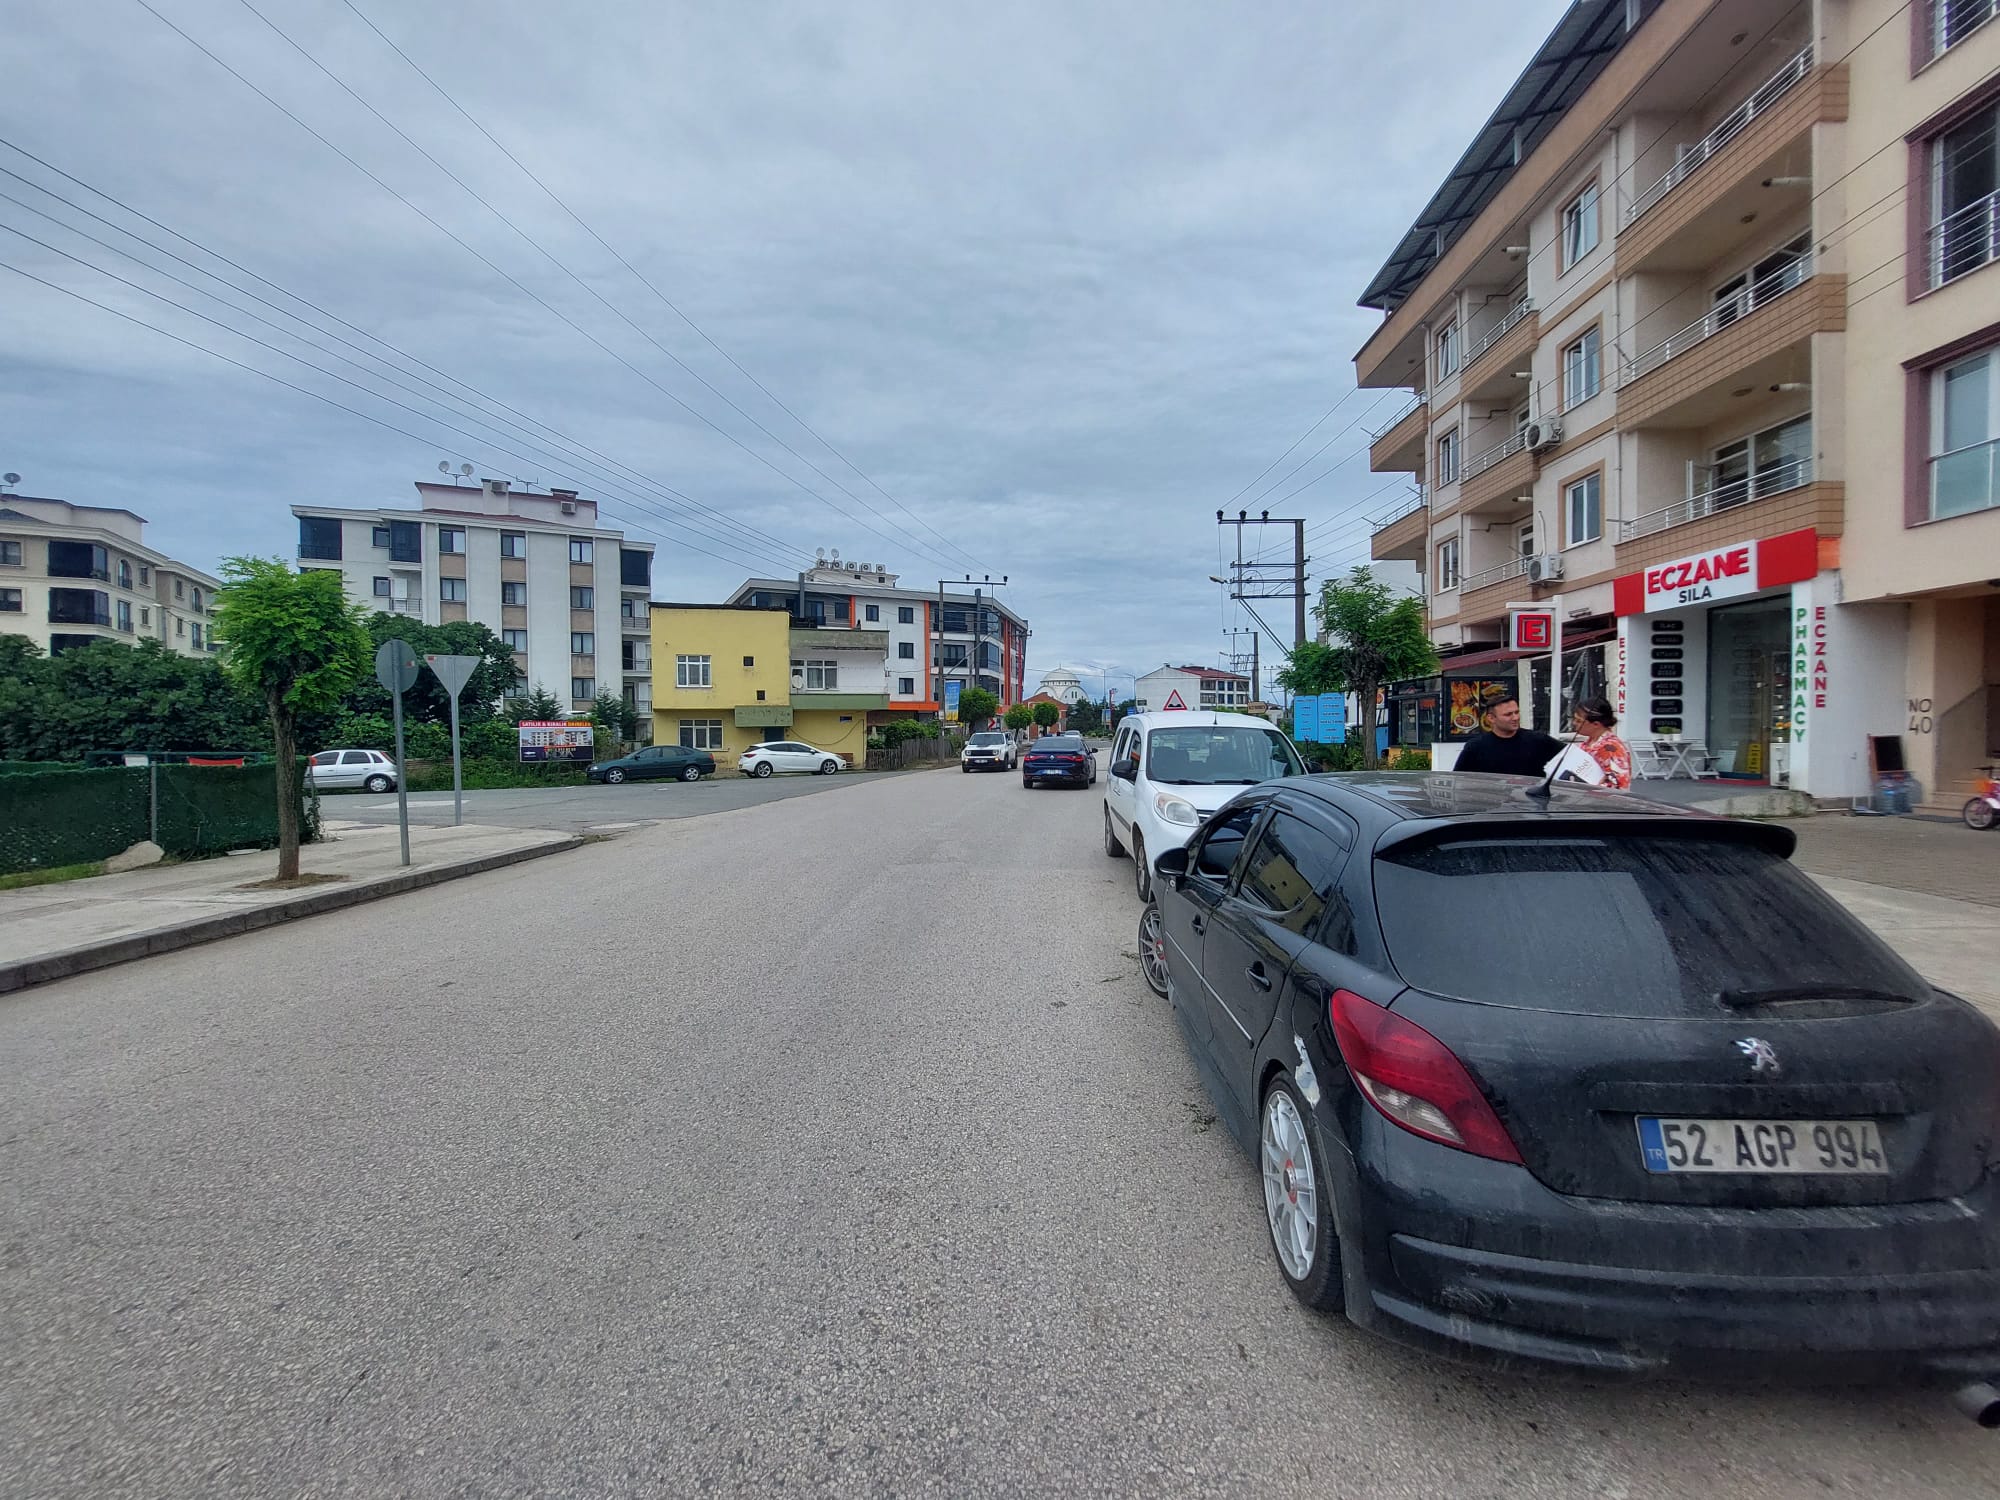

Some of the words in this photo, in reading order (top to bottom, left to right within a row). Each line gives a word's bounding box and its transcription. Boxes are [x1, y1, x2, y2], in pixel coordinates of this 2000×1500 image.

[1648, 547, 1750, 594] ECZANE
[1678, 585, 1713, 604] SILA
[1523, 618, 1545, 642] E
[1814, 606, 1827, 709] ECZANE
[1795, 607, 1807, 744] PHARMACY
[1909, 698, 1932, 714] NO
[1908, 717, 1932, 734] 40
[1648, 1149, 1664, 1161] TR
[1662, 1124, 1713, 1167] 52
[1734, 1124, 1797, 1168] AGP
[1813, 1125, 1882, 1169] 994
